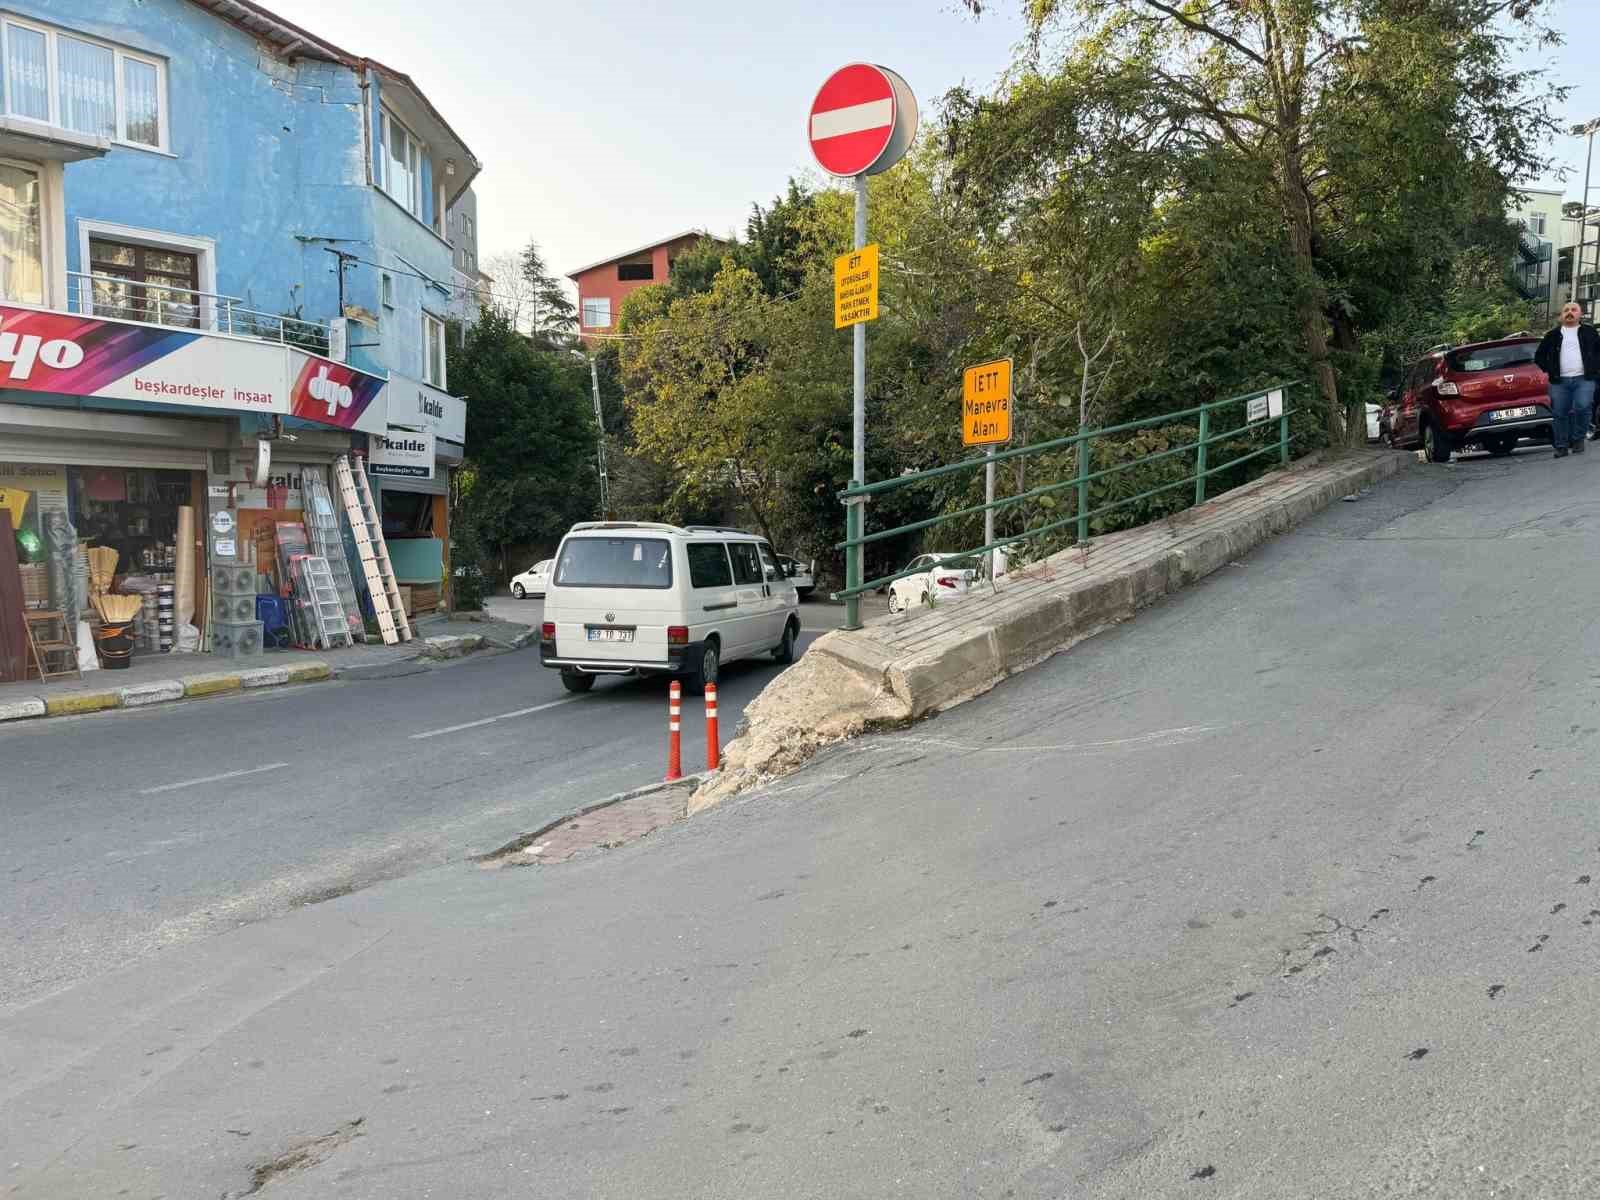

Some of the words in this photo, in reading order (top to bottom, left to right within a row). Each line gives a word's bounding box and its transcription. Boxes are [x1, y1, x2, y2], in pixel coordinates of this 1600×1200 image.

[841, 308, 870, 322] YASAKTIR
[134, 377, 225, 400] beşkardeşler
[233, 387, 273, 404] inşaat
[308, 366, 353, 417] dyo
[974, 371, 999, 393] İETT
[424, 396, 443, 418] kalde
[965, 398, 1008, 417] Manevra
[972, 419, 999, 438] Alanı
[386, 439, 425, 452] kalde
